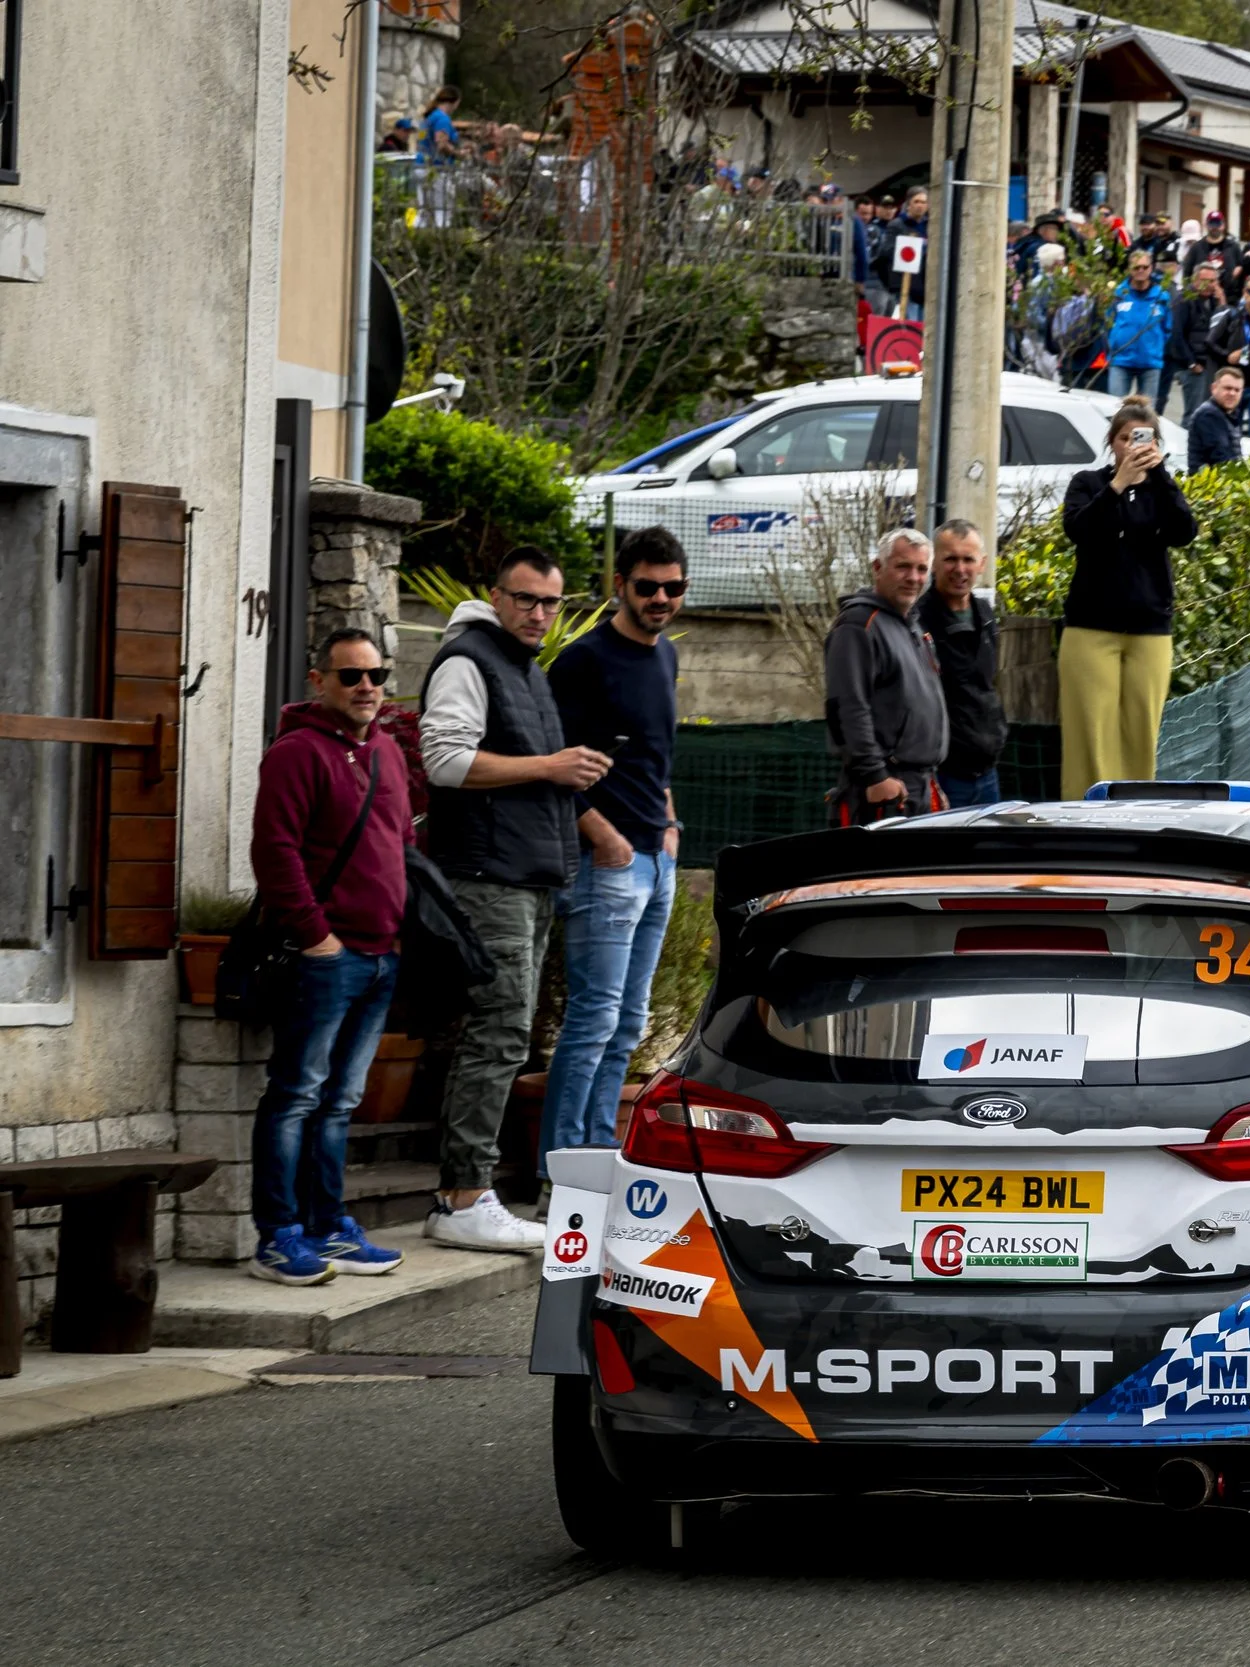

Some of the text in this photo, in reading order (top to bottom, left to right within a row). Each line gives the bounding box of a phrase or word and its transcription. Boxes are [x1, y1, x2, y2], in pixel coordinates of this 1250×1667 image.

[241, 588, 270, 638] 19
[990, 1047, 1063, 1064] JANAF
[977, 1103, 1011, 1119] Ford
[914, 1175, 1090, 1208] PX24 BWL
[966, 1236, 1079, 1254] CARLSSON
[545, 1265, 591, 1273] TRENDAB
[969, 1256, 1075, 1265] BYGGARE AB
[720, 1348, 1114, 1395] M-SPORT
[1209, 1356, 1248, 1389] M
